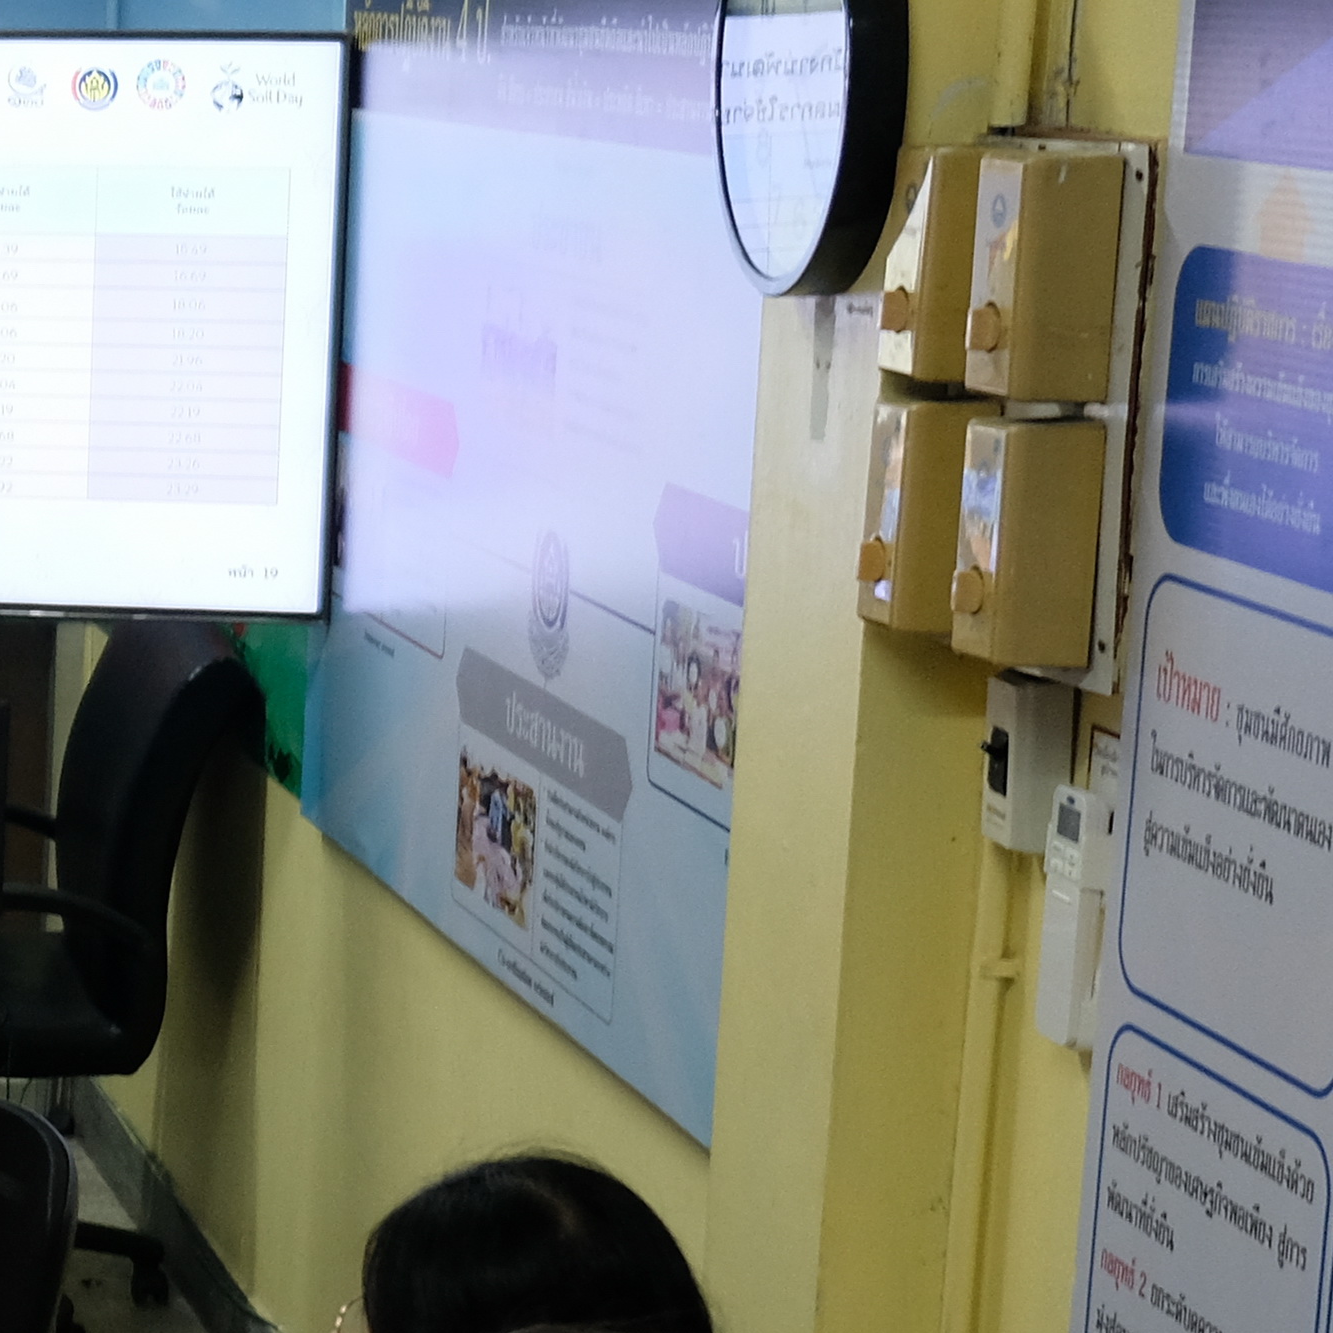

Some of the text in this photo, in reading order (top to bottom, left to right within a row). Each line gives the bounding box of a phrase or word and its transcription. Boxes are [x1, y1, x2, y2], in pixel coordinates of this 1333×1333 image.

[255, 73, 296, 87] World
[276, 90, 303, 109] Day
[261, 566, 279, 580] 19
[1157, 650, 1222, 723] เป้าหมาย
[505, 690, 585, 778] ประสานงาน
